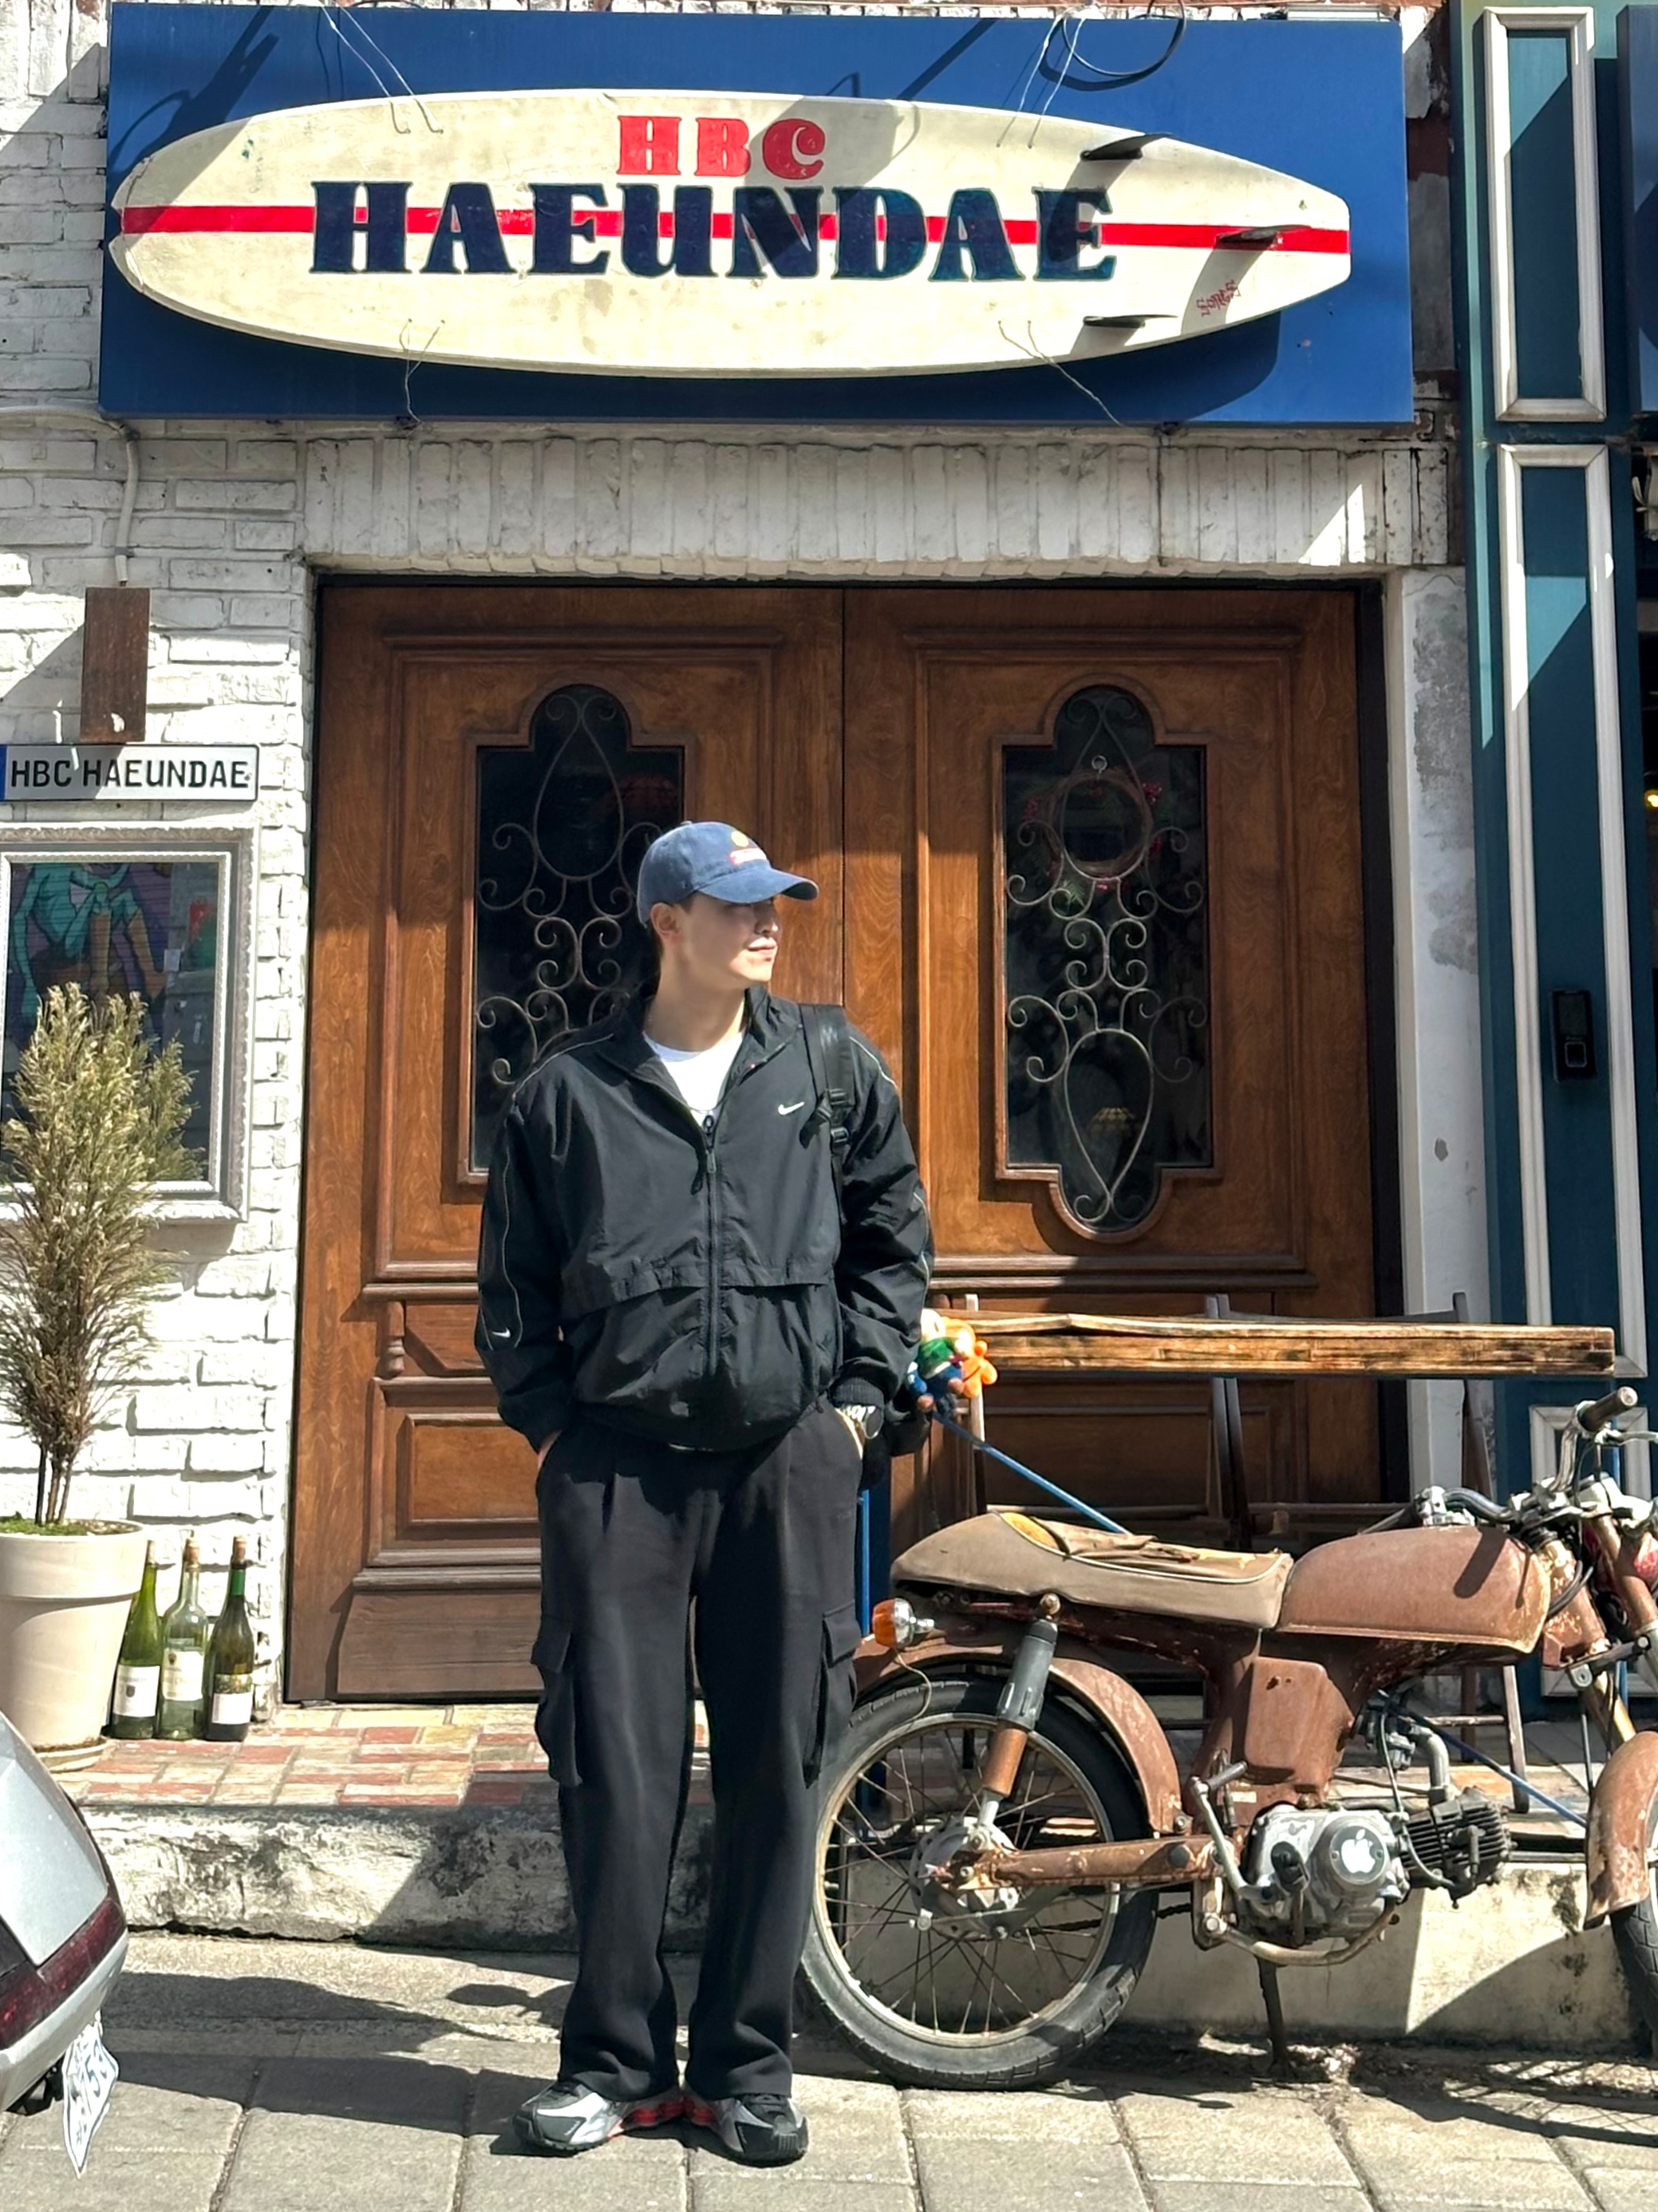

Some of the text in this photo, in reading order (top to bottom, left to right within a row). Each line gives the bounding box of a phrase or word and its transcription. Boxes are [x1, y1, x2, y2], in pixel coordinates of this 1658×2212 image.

[618, 115, 826, 180] HBC
[310, 180, 1117, 282] HAEUNDAE
[11, 760, 249, 788] HBC HAEUNDAE
